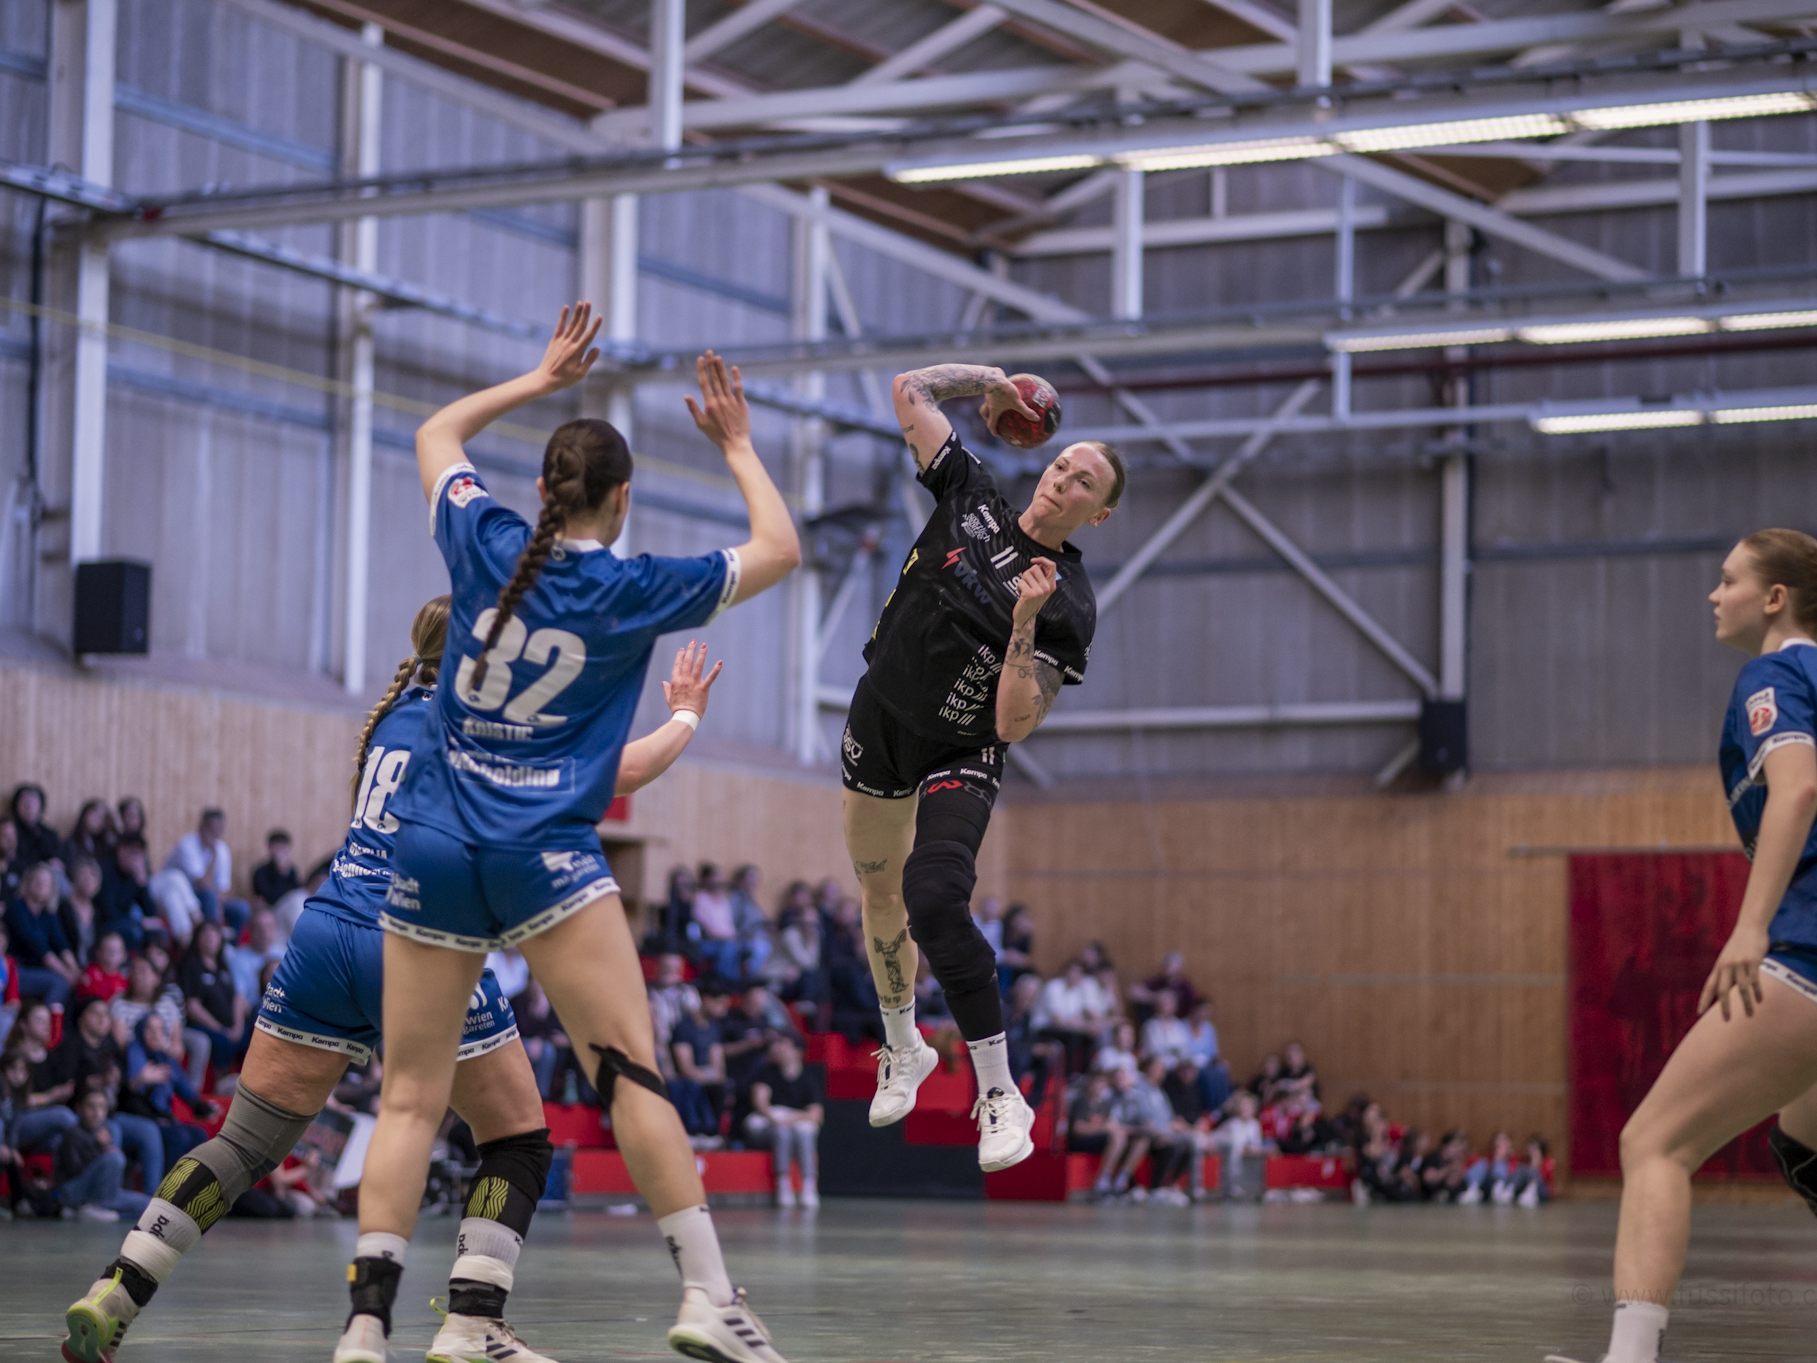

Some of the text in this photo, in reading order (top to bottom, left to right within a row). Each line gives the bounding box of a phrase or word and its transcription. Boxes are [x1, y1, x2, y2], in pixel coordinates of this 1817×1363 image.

[978, 503, 1001, 534] Kempa
[990, 545, 1019, 570] 11
[1033, 649, 1059, 667] Kempa
[455, 607, 587, 728] 32
[960, 768, 988, 780] Kempa
[351, 745, 412, 835] 18
[856, 781, 885, 797] Kempa
[277, 1027, 304, 1041] Kempa
[463, 1019, 496, 1036] gareten
[311, 1035, 340, 1049] Kempa
